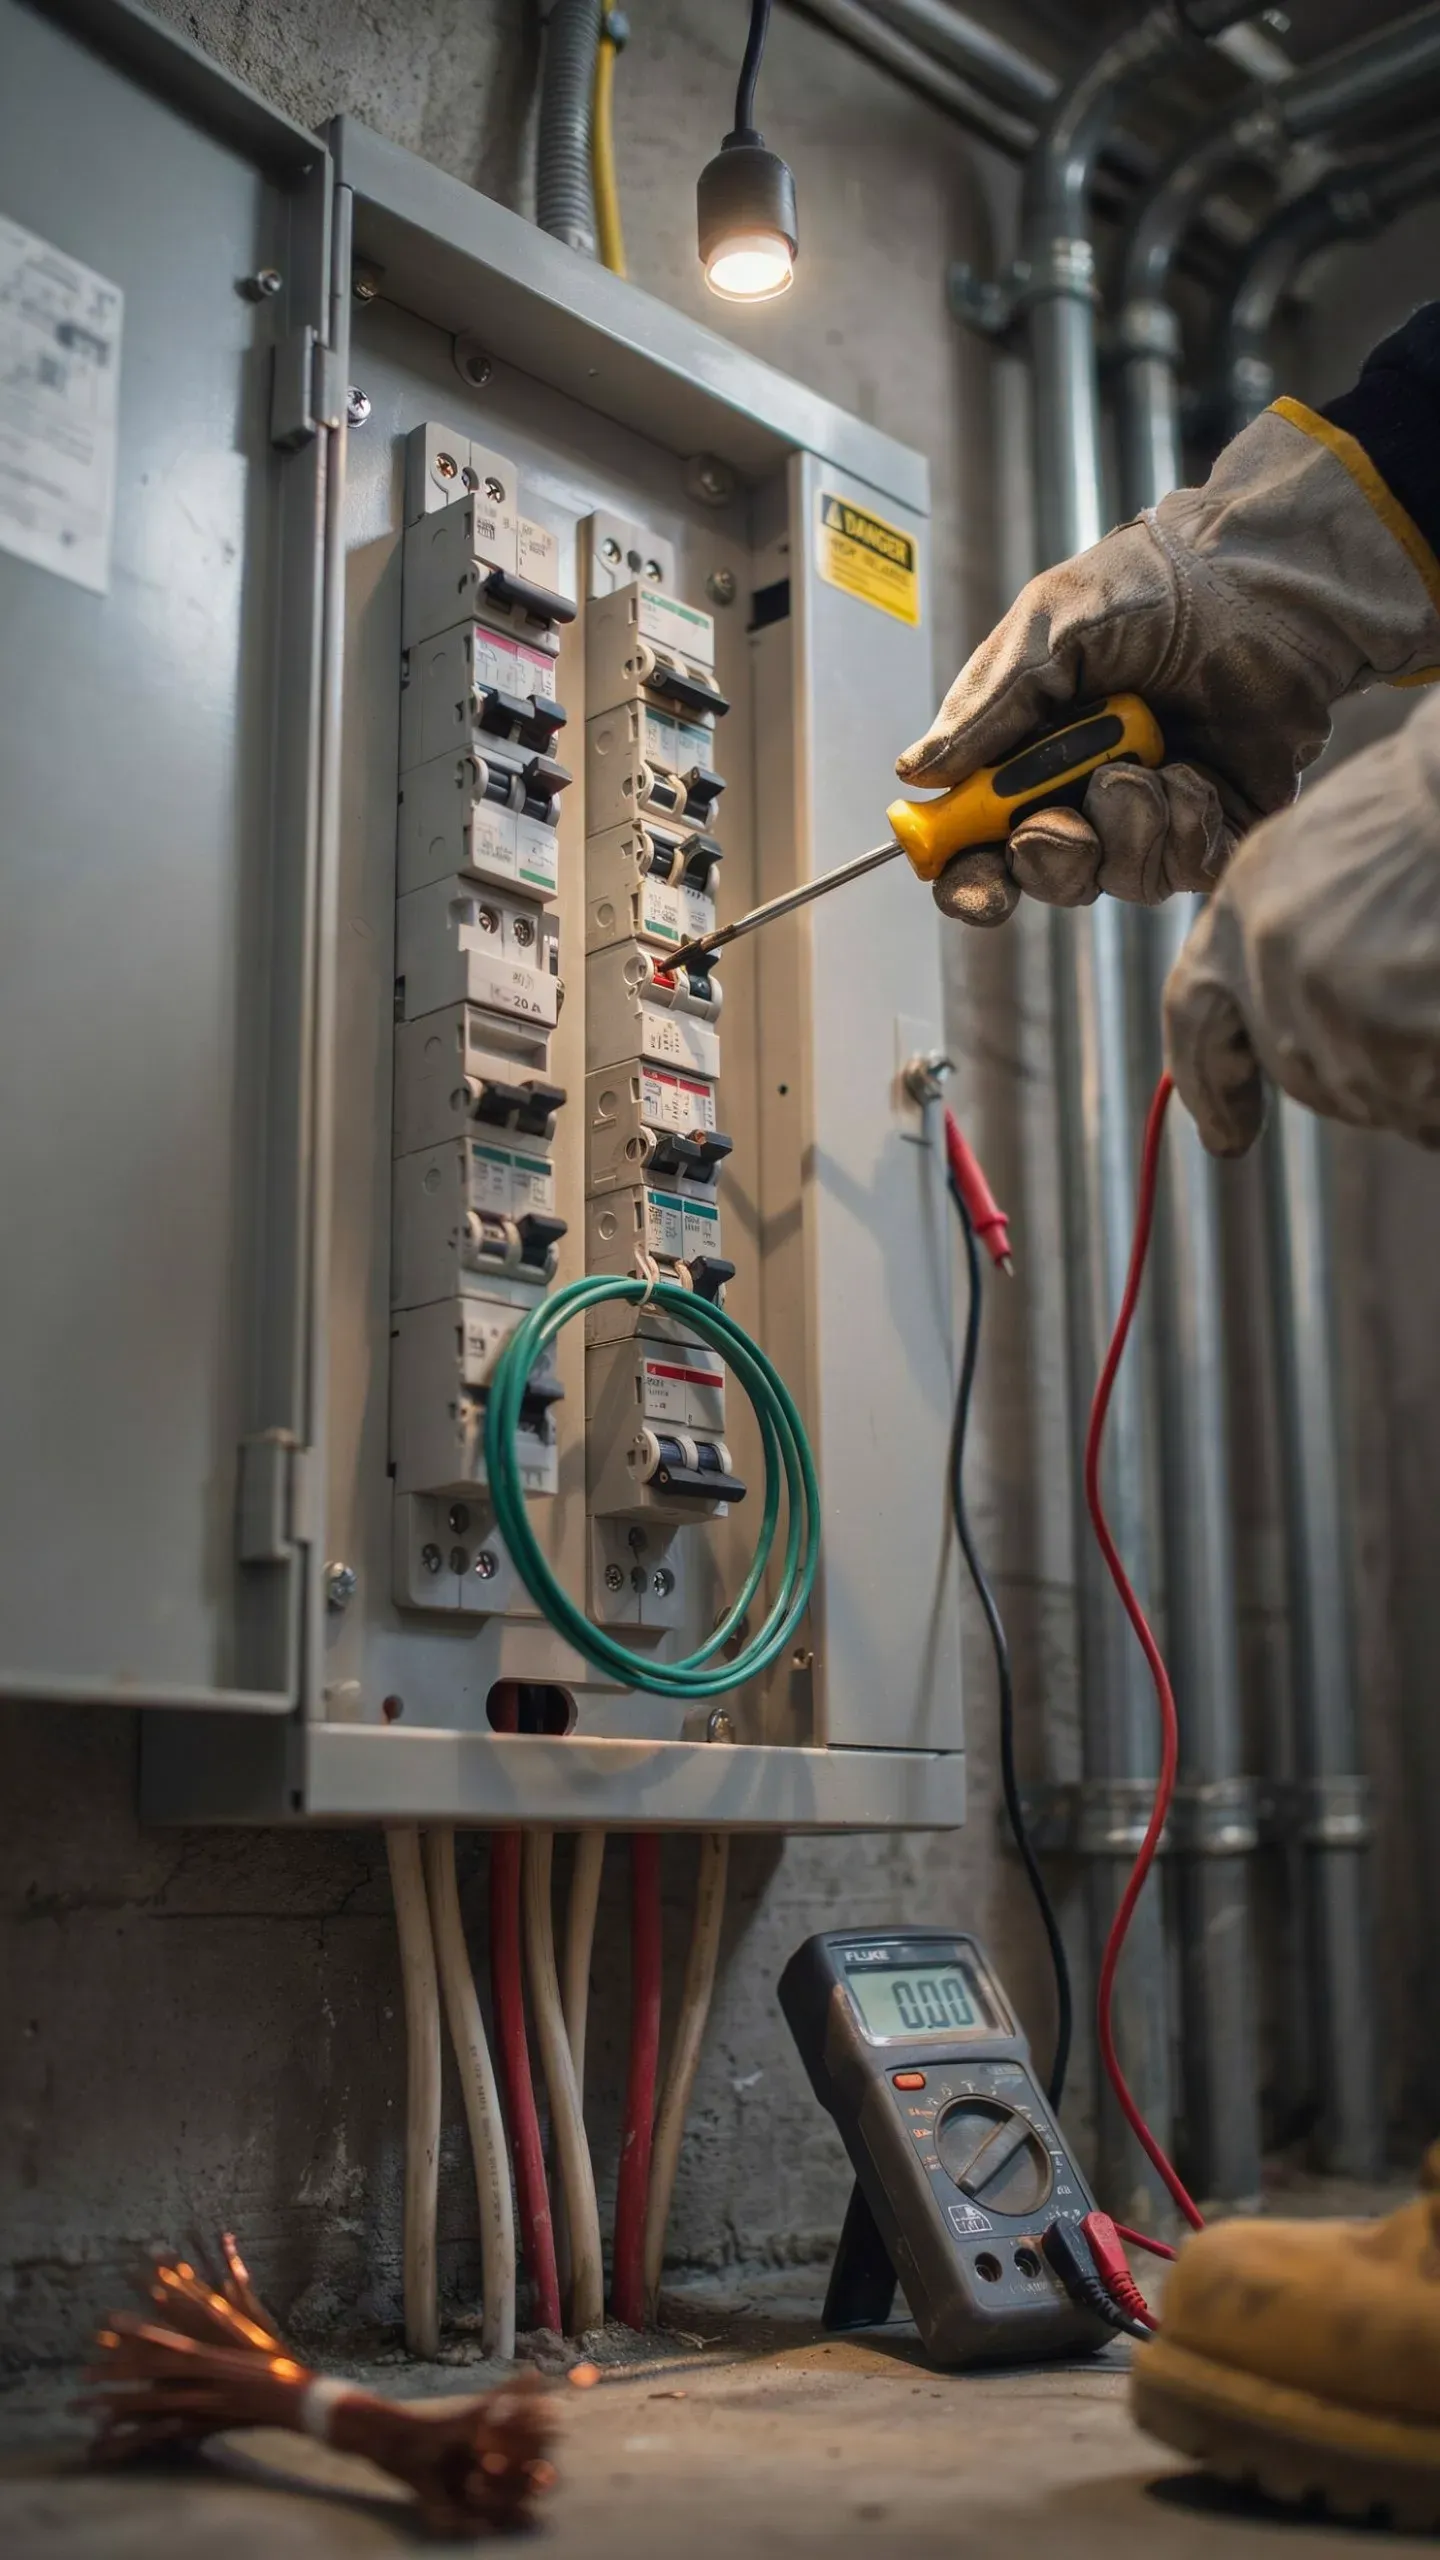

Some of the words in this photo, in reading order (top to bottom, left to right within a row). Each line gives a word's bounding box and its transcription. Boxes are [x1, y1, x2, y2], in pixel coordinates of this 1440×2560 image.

[847, 510, 907, 566] DANGER
[513, 995, 529, 1010] 20
[844, 1951, 890, 1961] FLUKE
